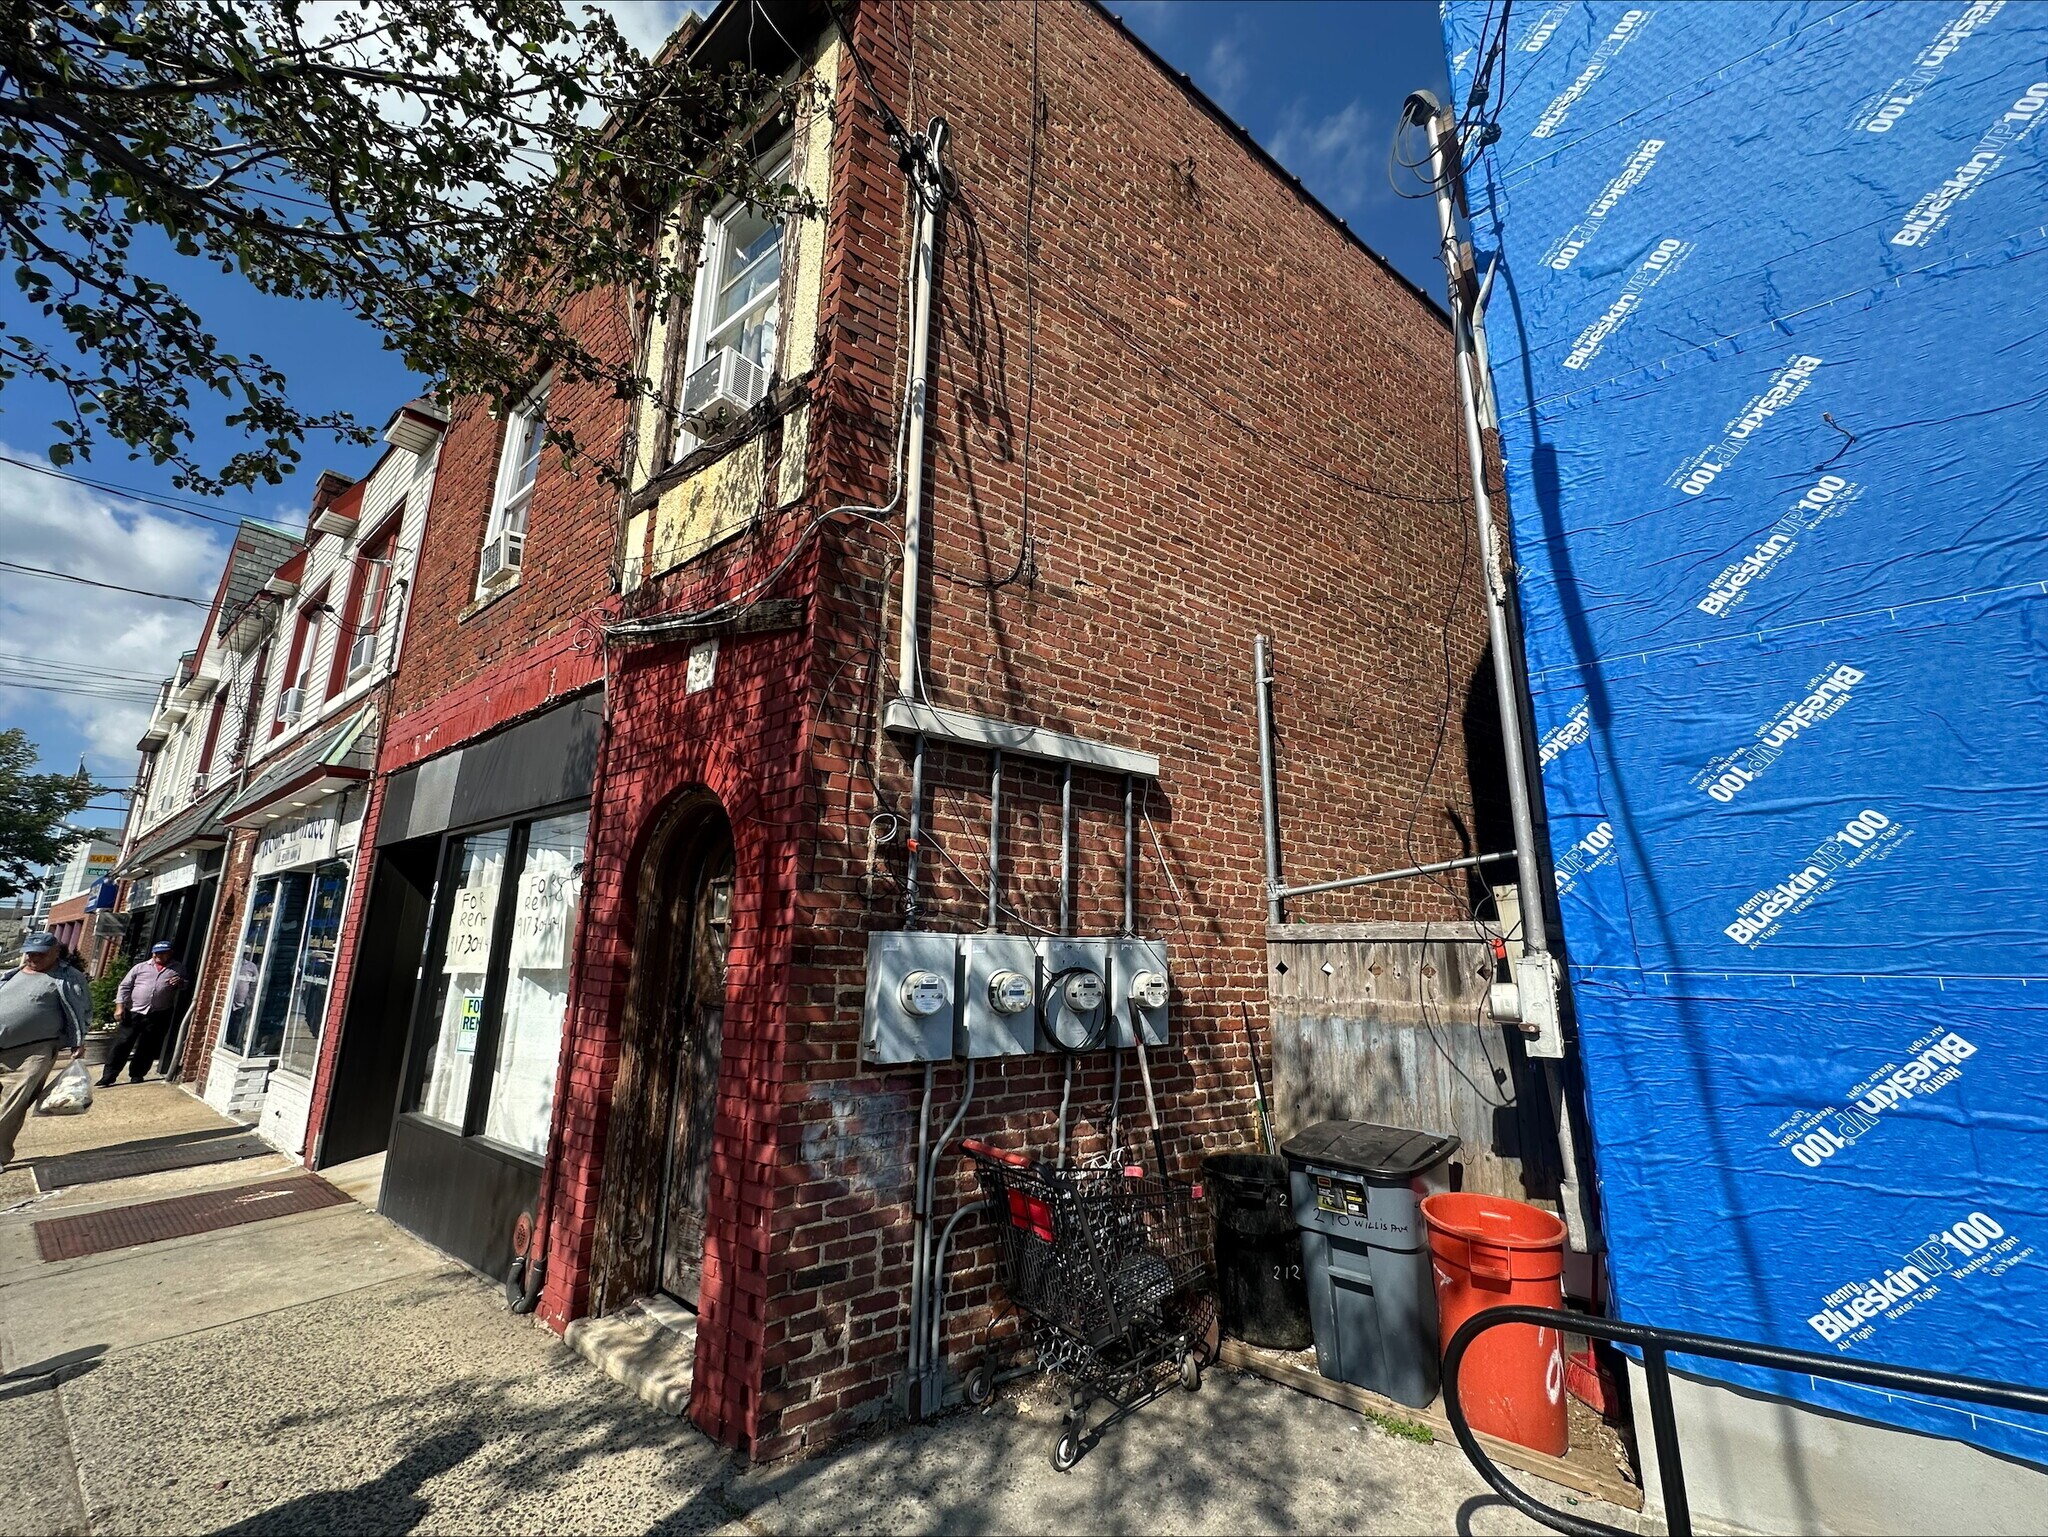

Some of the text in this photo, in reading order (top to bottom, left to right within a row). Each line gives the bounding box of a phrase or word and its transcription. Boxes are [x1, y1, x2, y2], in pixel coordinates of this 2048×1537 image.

[1902, 192, 1937, 222] Henry
[1781, 379, 1812, 406] Henry
[1707, 564, 1739, 590] Henry
[1825, 662, 1837, 672] Air
[1804, 674, 1825, 690] Tight
[1774, 701, 1797, 720] Water
[1816, 692, 1852, 720] Henry
[1754, 722, 1775, 737] Tight
[1716, 748, 1747, 773] Weather
[1697, 775, 1717, 791] Tight
[530, 873, 557, 896] FOR
[1749, 940, 1761, 950] Air
[1760, 924, 1782, 939] Tight
[1790, 895, 1815, 914] Water
[1815, 878, 1836, 895] Tight
[1845, 841, 1880, 868] Weather
[1878, 823, 1902, 840] Tight
[462, 891, 486, 909] FOR
[1736, 889, 1770, 916] Henry
[468, 999, 483, 1014] FO
[1930, 1025, 1945, 1036] Air
[1906, 1035, 1932, 1055] Tight
[1869, 1062, 1897, 1082] Water
[1920, 1066, 1963, 1095] Henry
[1846, 1080, 1870, 1099] Tight
[1800, 1106, 1837, 1132] Weather
[1779, 1130, 1801, 1147] Tight
[1274, 1265, 1301, 1280] 212
[1822, 1281, 1863, 1309] Henry
[1836, 1235, 2020, 1351] Air Tight Water Tight Weather Tight
